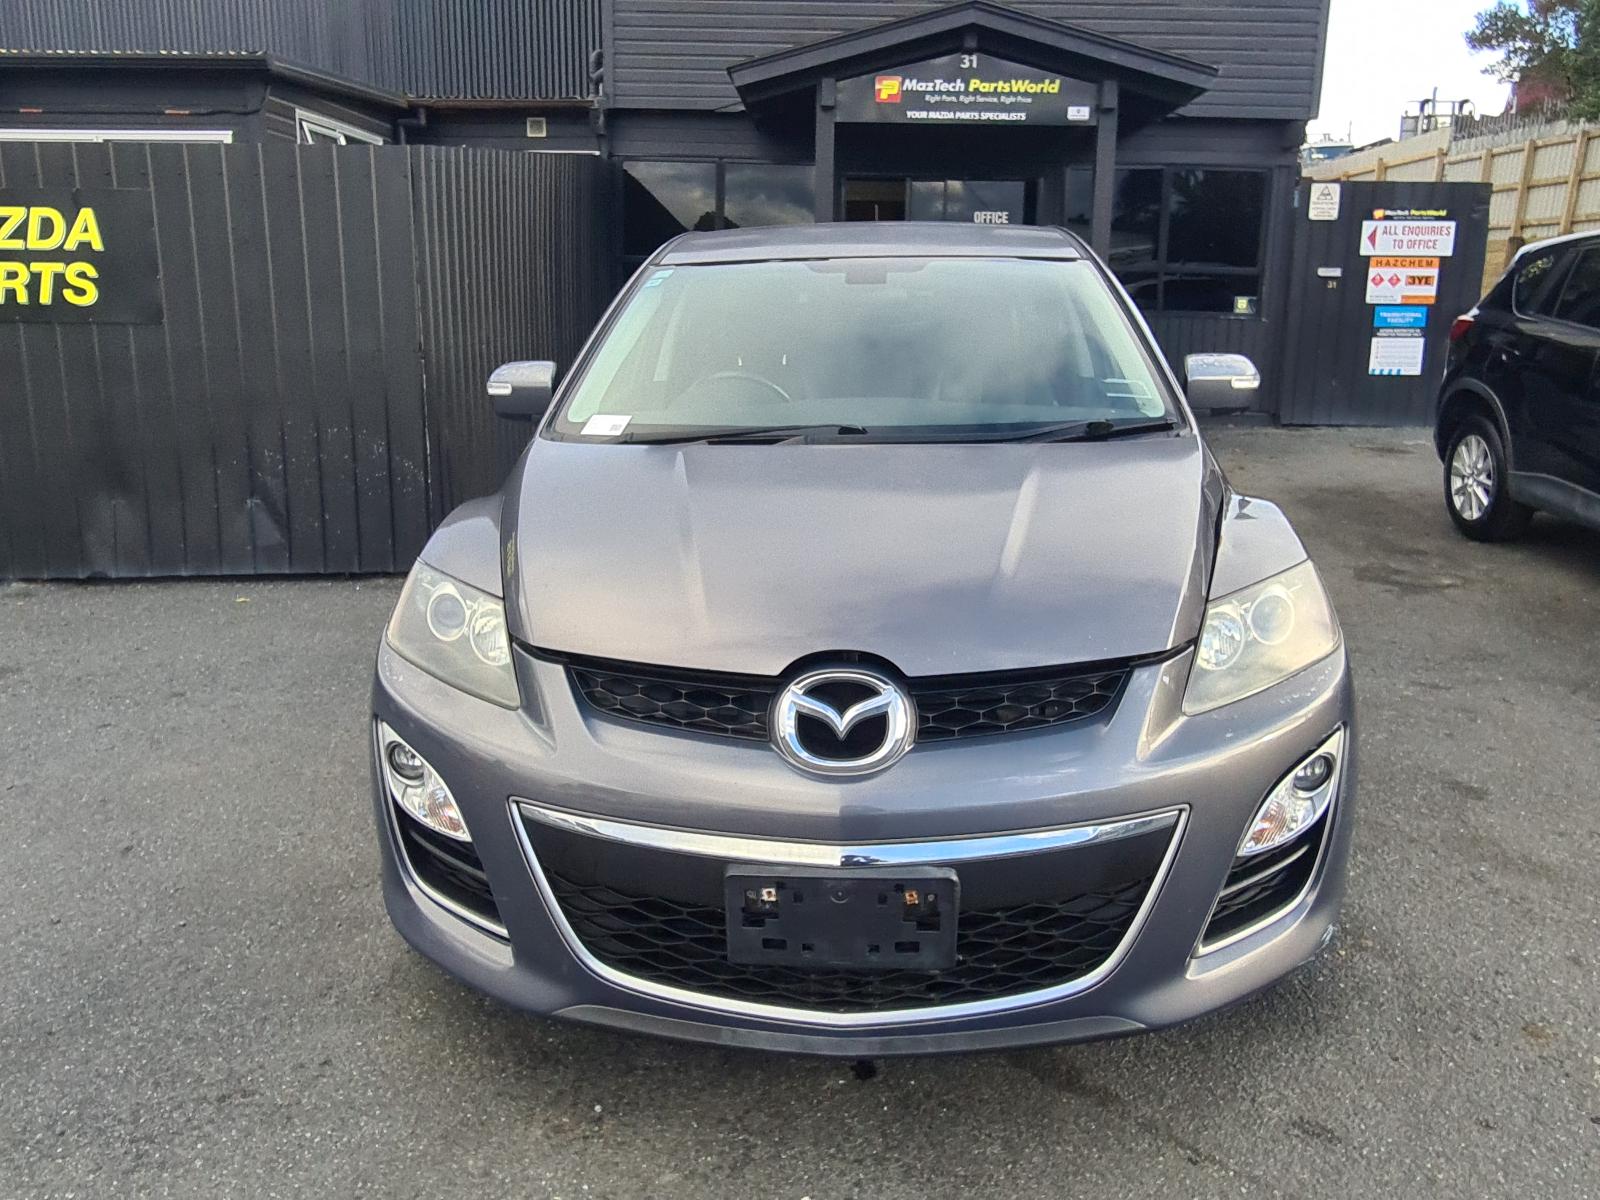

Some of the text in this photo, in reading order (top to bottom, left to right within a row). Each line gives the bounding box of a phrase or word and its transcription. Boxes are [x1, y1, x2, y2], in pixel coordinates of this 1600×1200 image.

[960, 54, 978, 69] 31
[902, 79, 1060, 94] MazTech PartsWorld
[925, 95, 941, 103] Right
[959, 95, 975, 104] Right
[1000, 96, 1016, 104] Right
[906, 111, 1026, 120] YOUR MAZDA PARTS SPECIALISTS
[973, 211, 1009, 224] OFFICE
[1382, 226, 1451, 237] ALL ENQUIRIES
[1393, 239, 1438, 250] TO OFFICE
[1375, 259, 1434, 267] HAZCHEM
[1327, 281, 1337, 289] 31
[1407, 275, 1433, 286] 3YE
